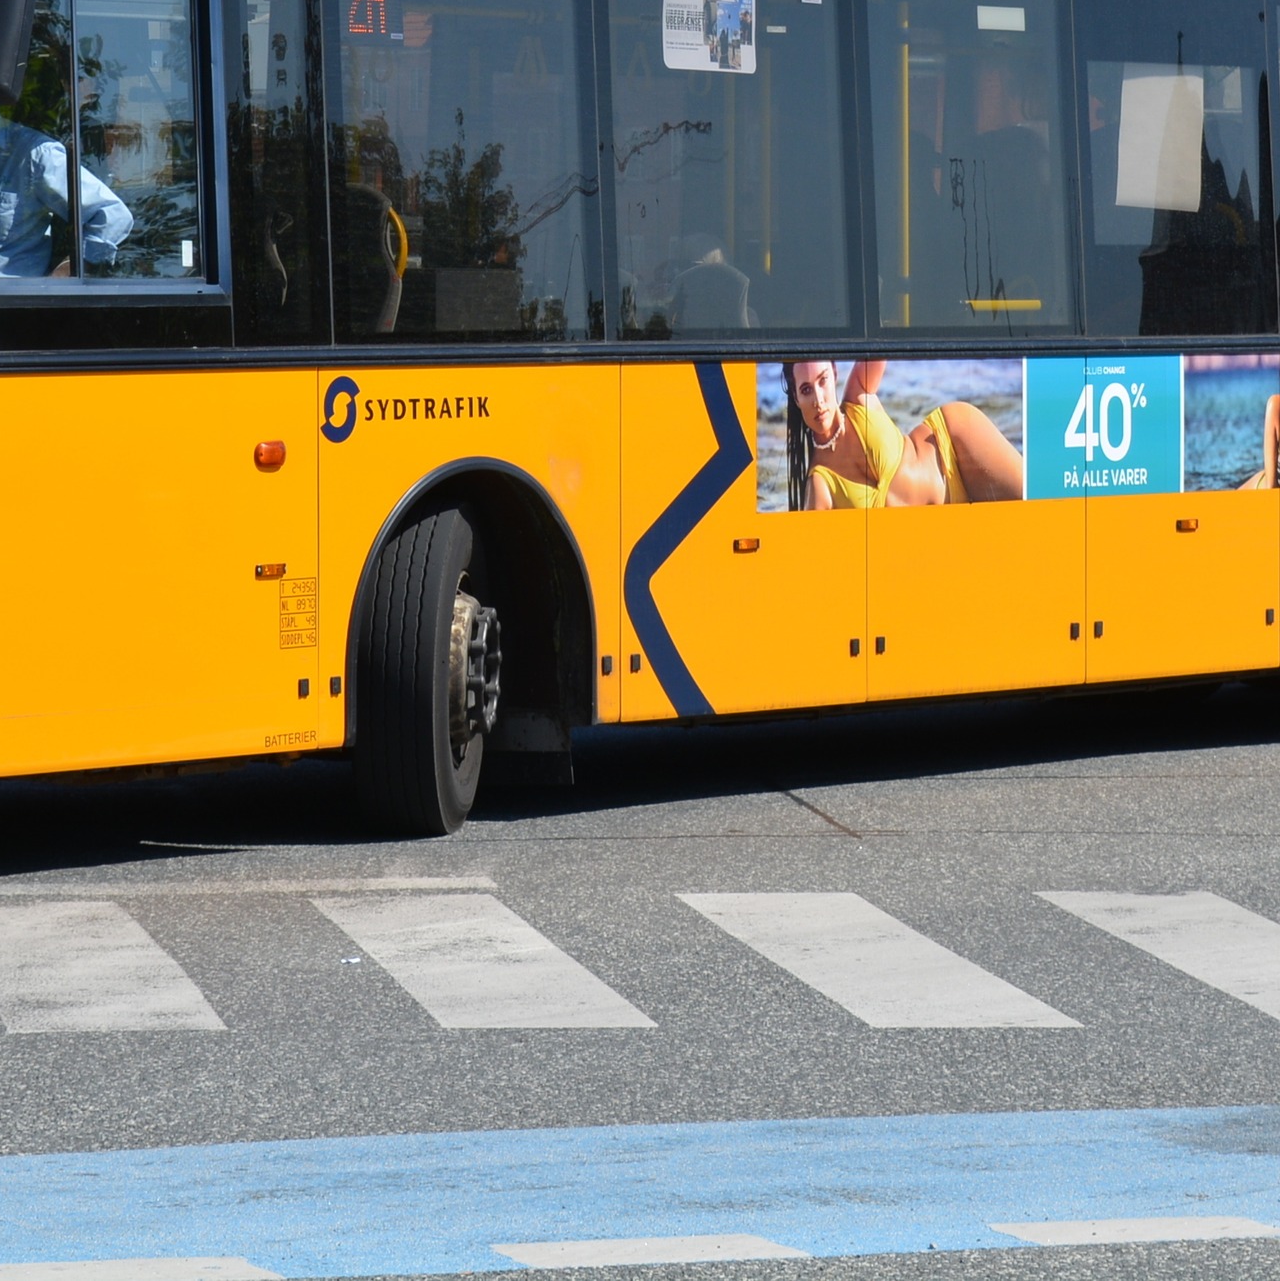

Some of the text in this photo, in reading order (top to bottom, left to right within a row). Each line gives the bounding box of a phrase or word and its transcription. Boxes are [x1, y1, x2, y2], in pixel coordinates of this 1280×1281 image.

[1103, 366, 1126, 375] CHANGE
[365, 397, 490, 421] SYDTRAFIK
[1064, 382, 1148, 462] 40%
[1064, 465, 1148, 489] PÅ ALLE VARER
[265, 730, 317, 748] BATTERIER
